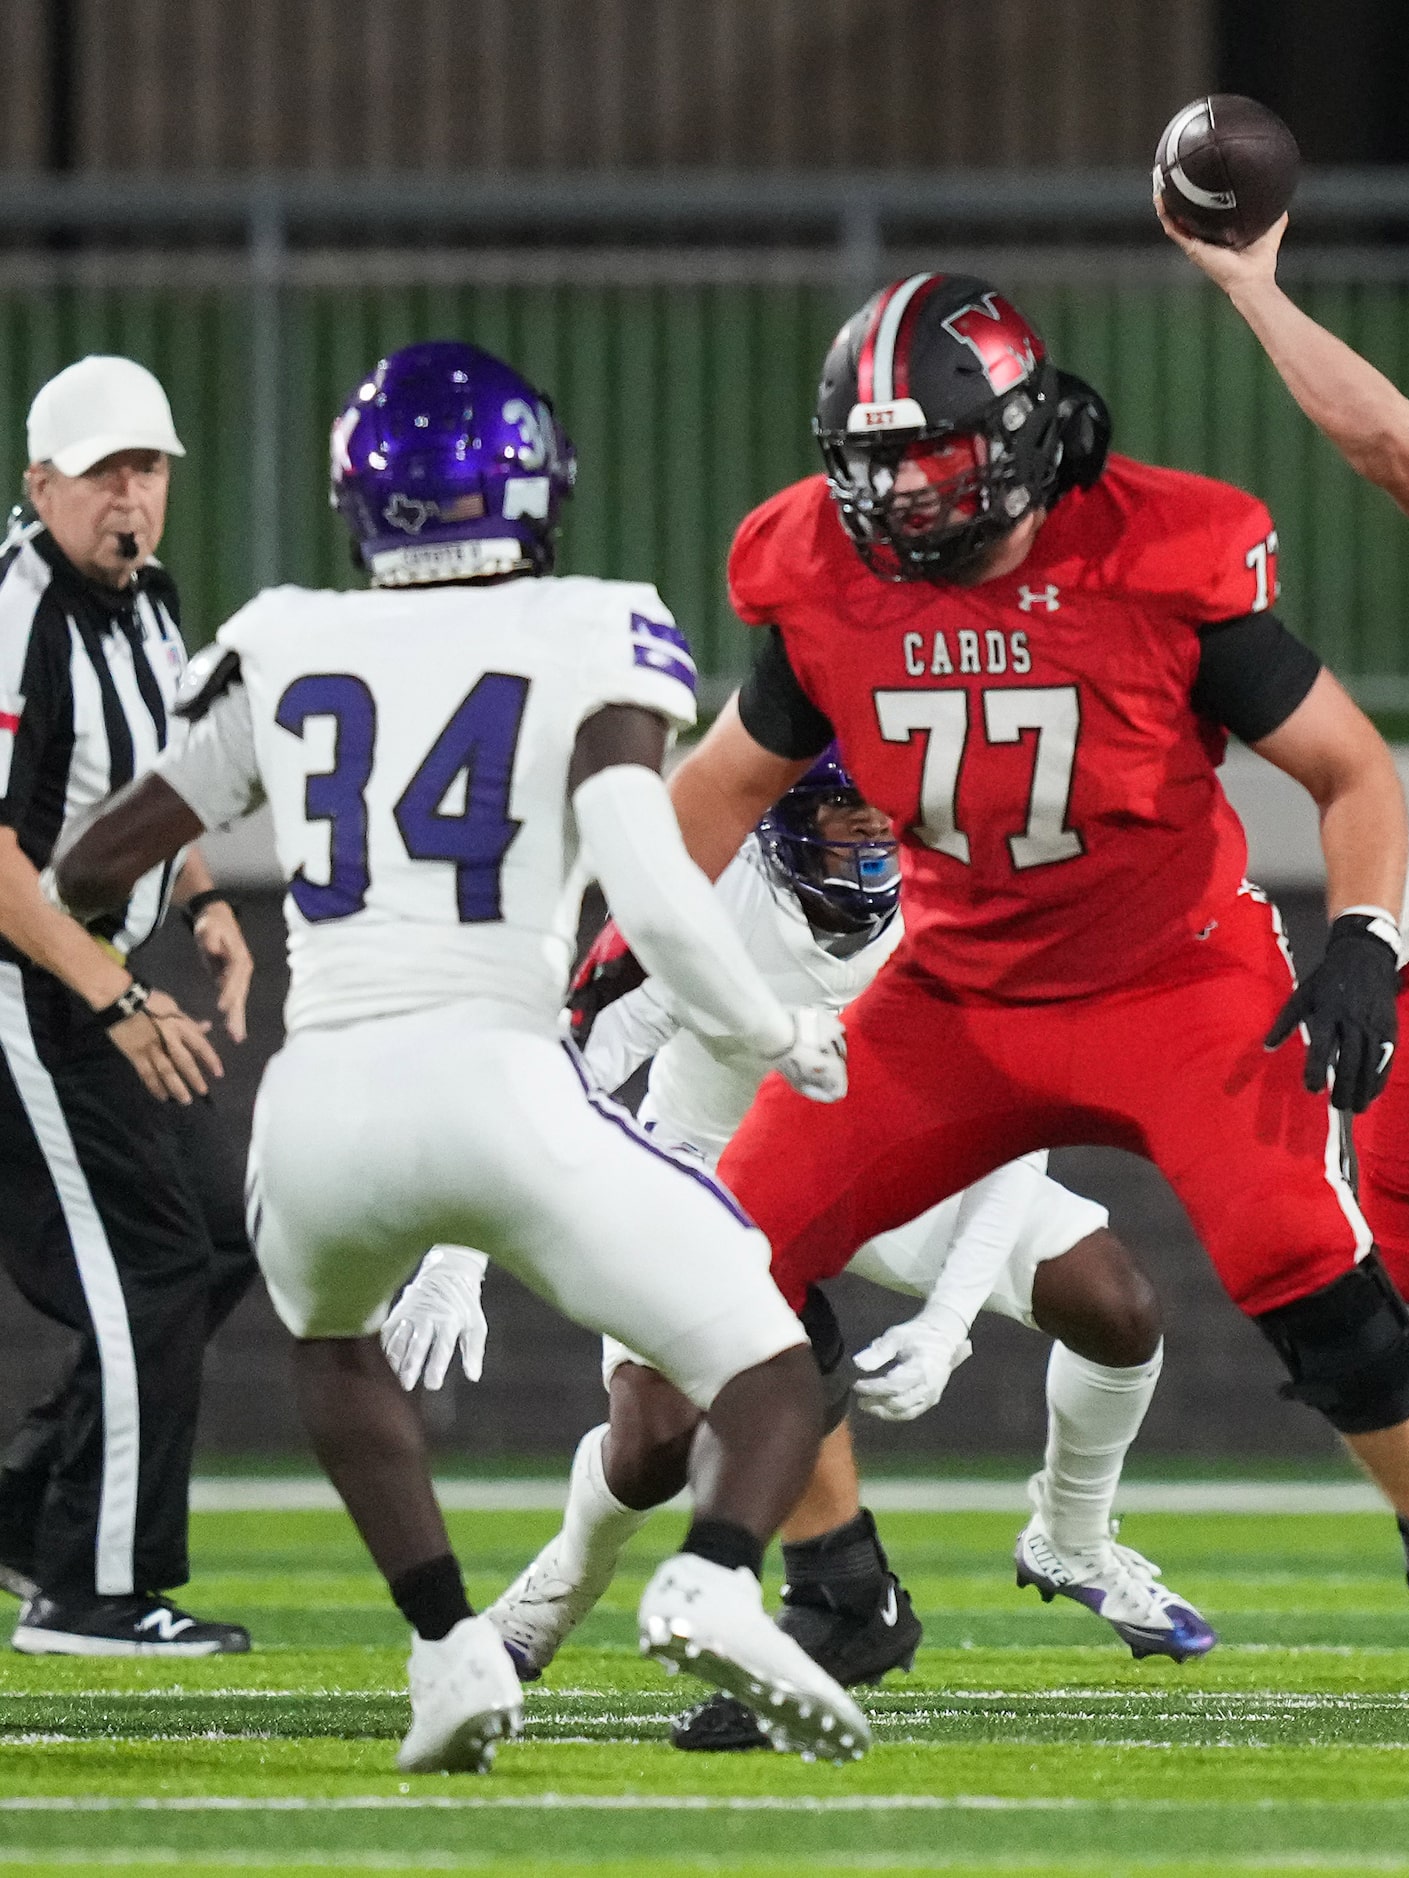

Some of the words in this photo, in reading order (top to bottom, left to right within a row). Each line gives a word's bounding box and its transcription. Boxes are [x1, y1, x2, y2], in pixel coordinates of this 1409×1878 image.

[903, 629, 1032, 677] CARDS
[274, 672, 531, 923] 34
[872, 684, 1085, 870] 77
[1028, 1534, 1075, 1587] NIKE
